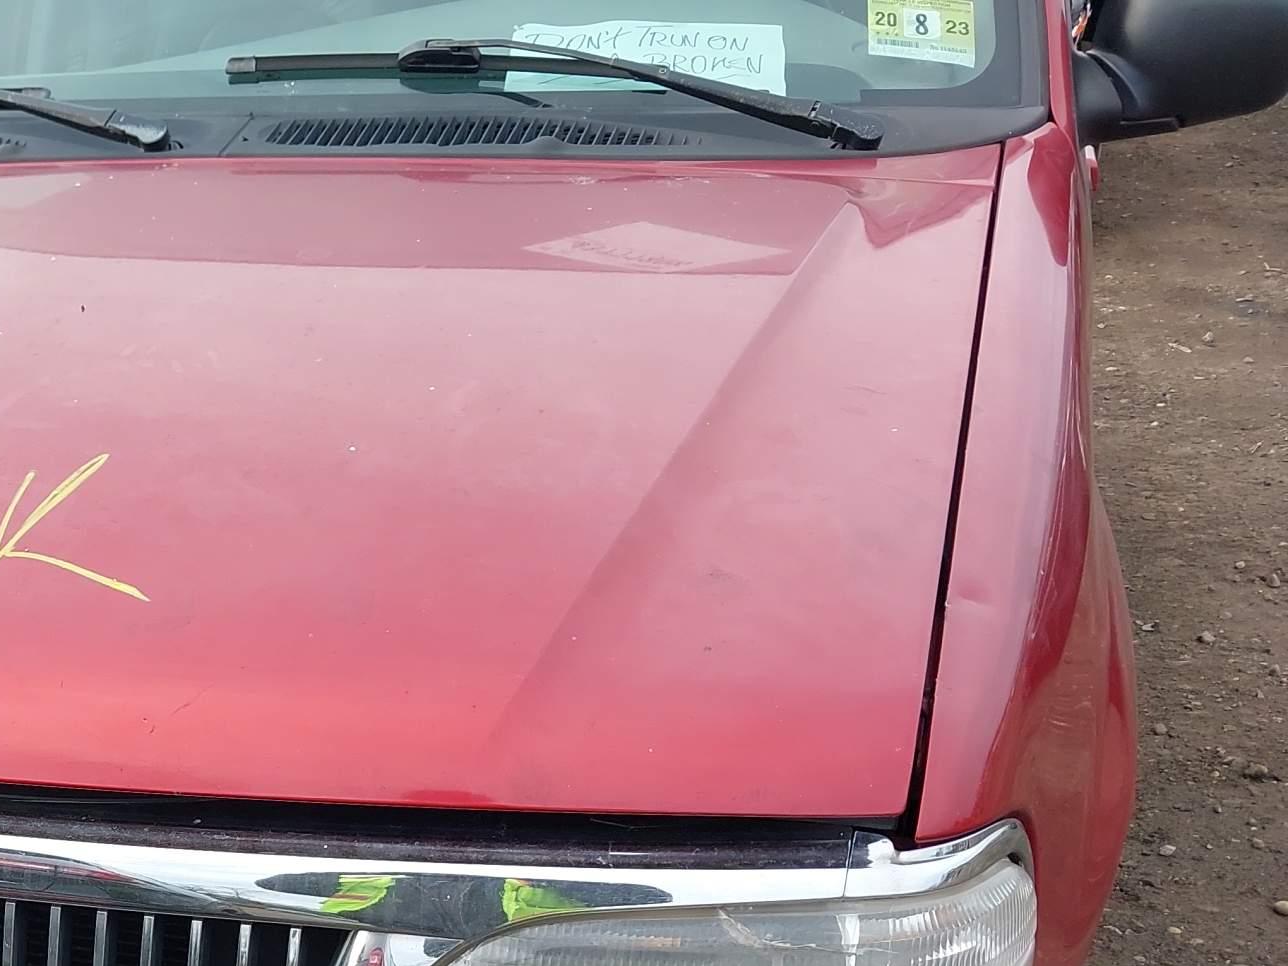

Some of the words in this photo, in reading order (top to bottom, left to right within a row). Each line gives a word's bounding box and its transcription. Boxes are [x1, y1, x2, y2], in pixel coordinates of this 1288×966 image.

[874, 11, 898, 28] 20
[915, 13, 929, 36] 8
[945, 20, 970, 36] 23
[706, 33, 749, 52] ON
